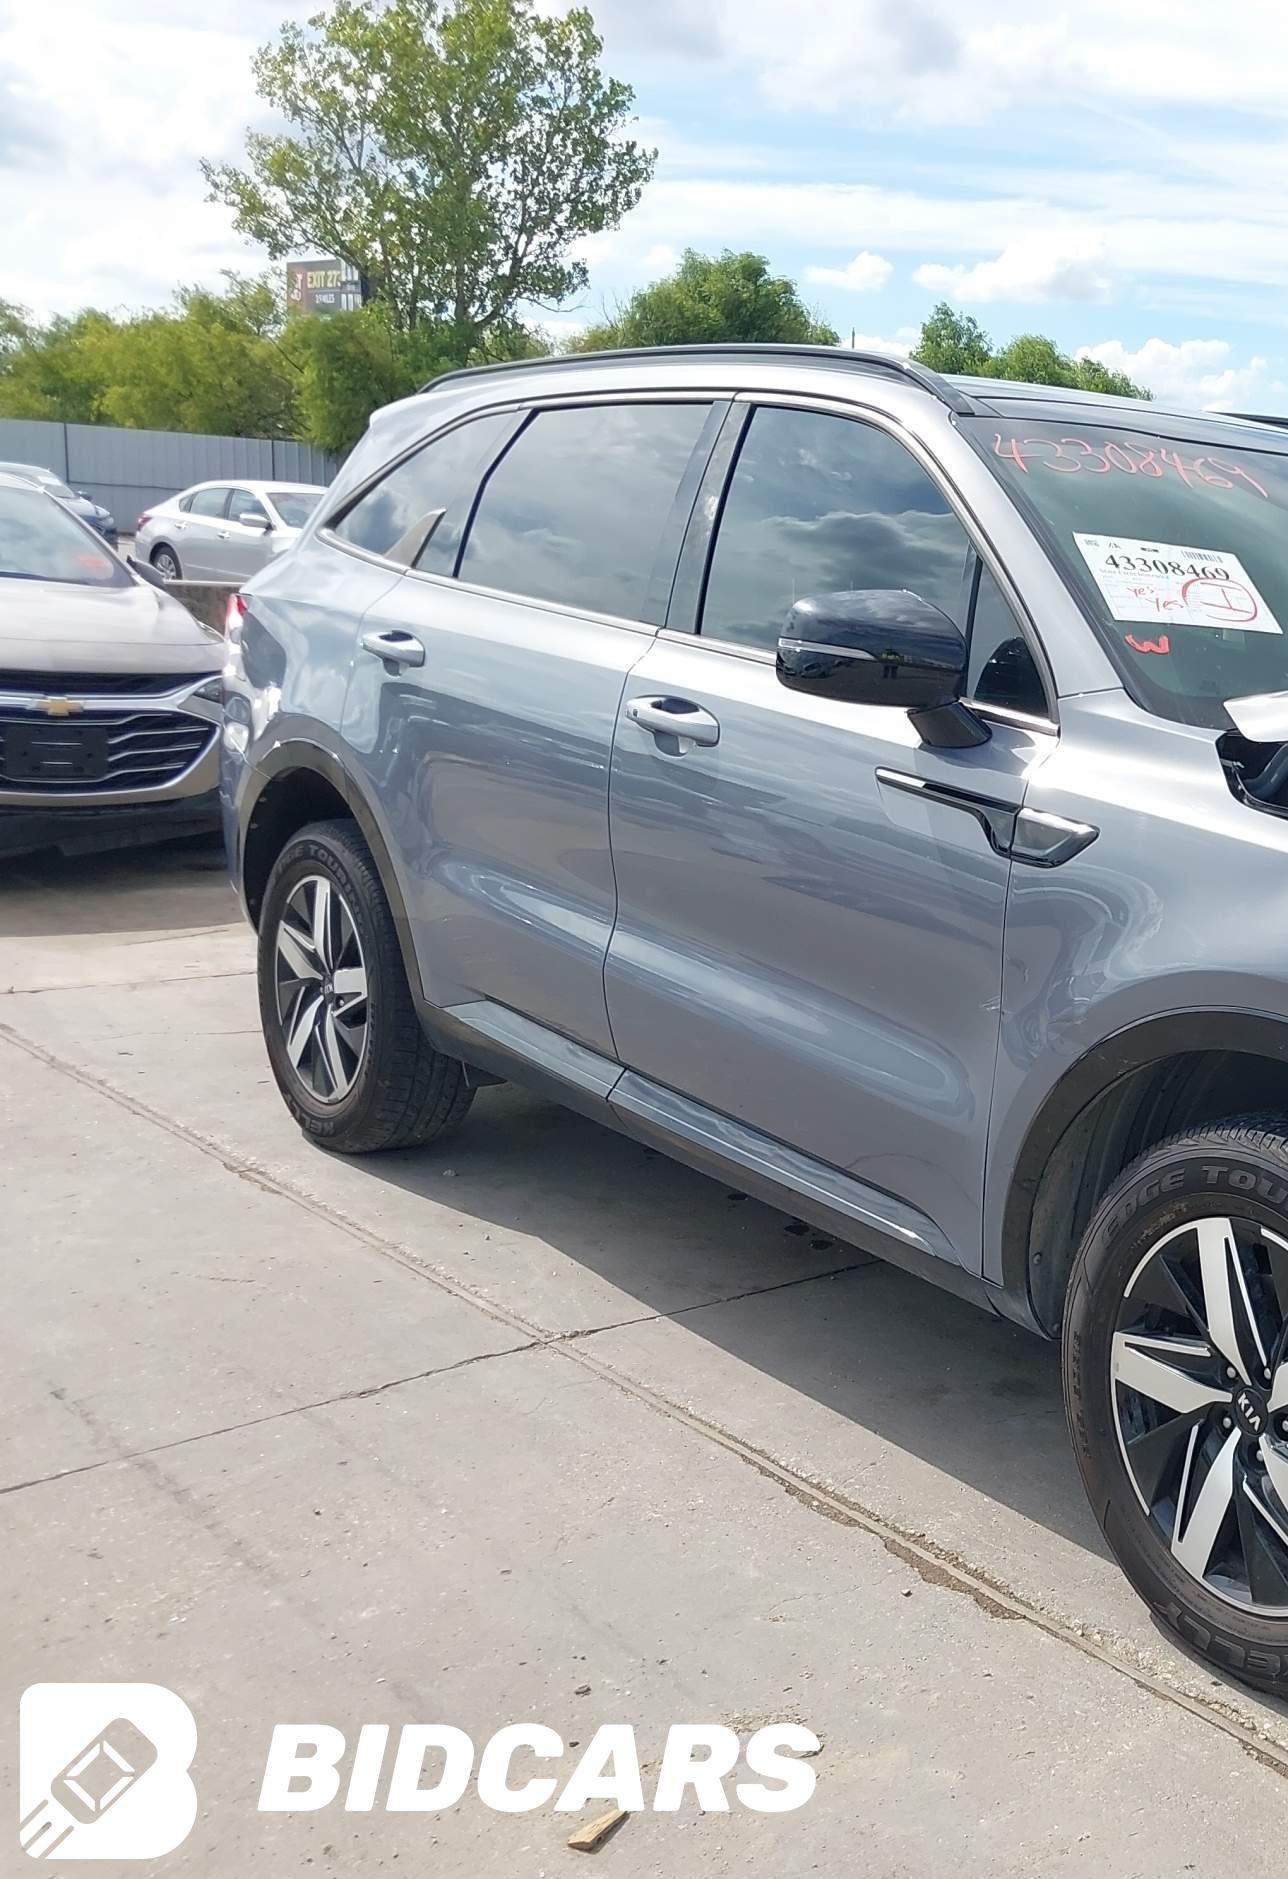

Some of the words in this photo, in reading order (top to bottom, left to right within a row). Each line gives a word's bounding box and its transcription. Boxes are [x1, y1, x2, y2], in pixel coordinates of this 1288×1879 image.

[307, 271, 326, 289] EXIT
[994, 433, 1269, 499] 43308469
[1105, 553, 1230, 581] 43308469
[1238, 1392, 1261, 1432] KIA
